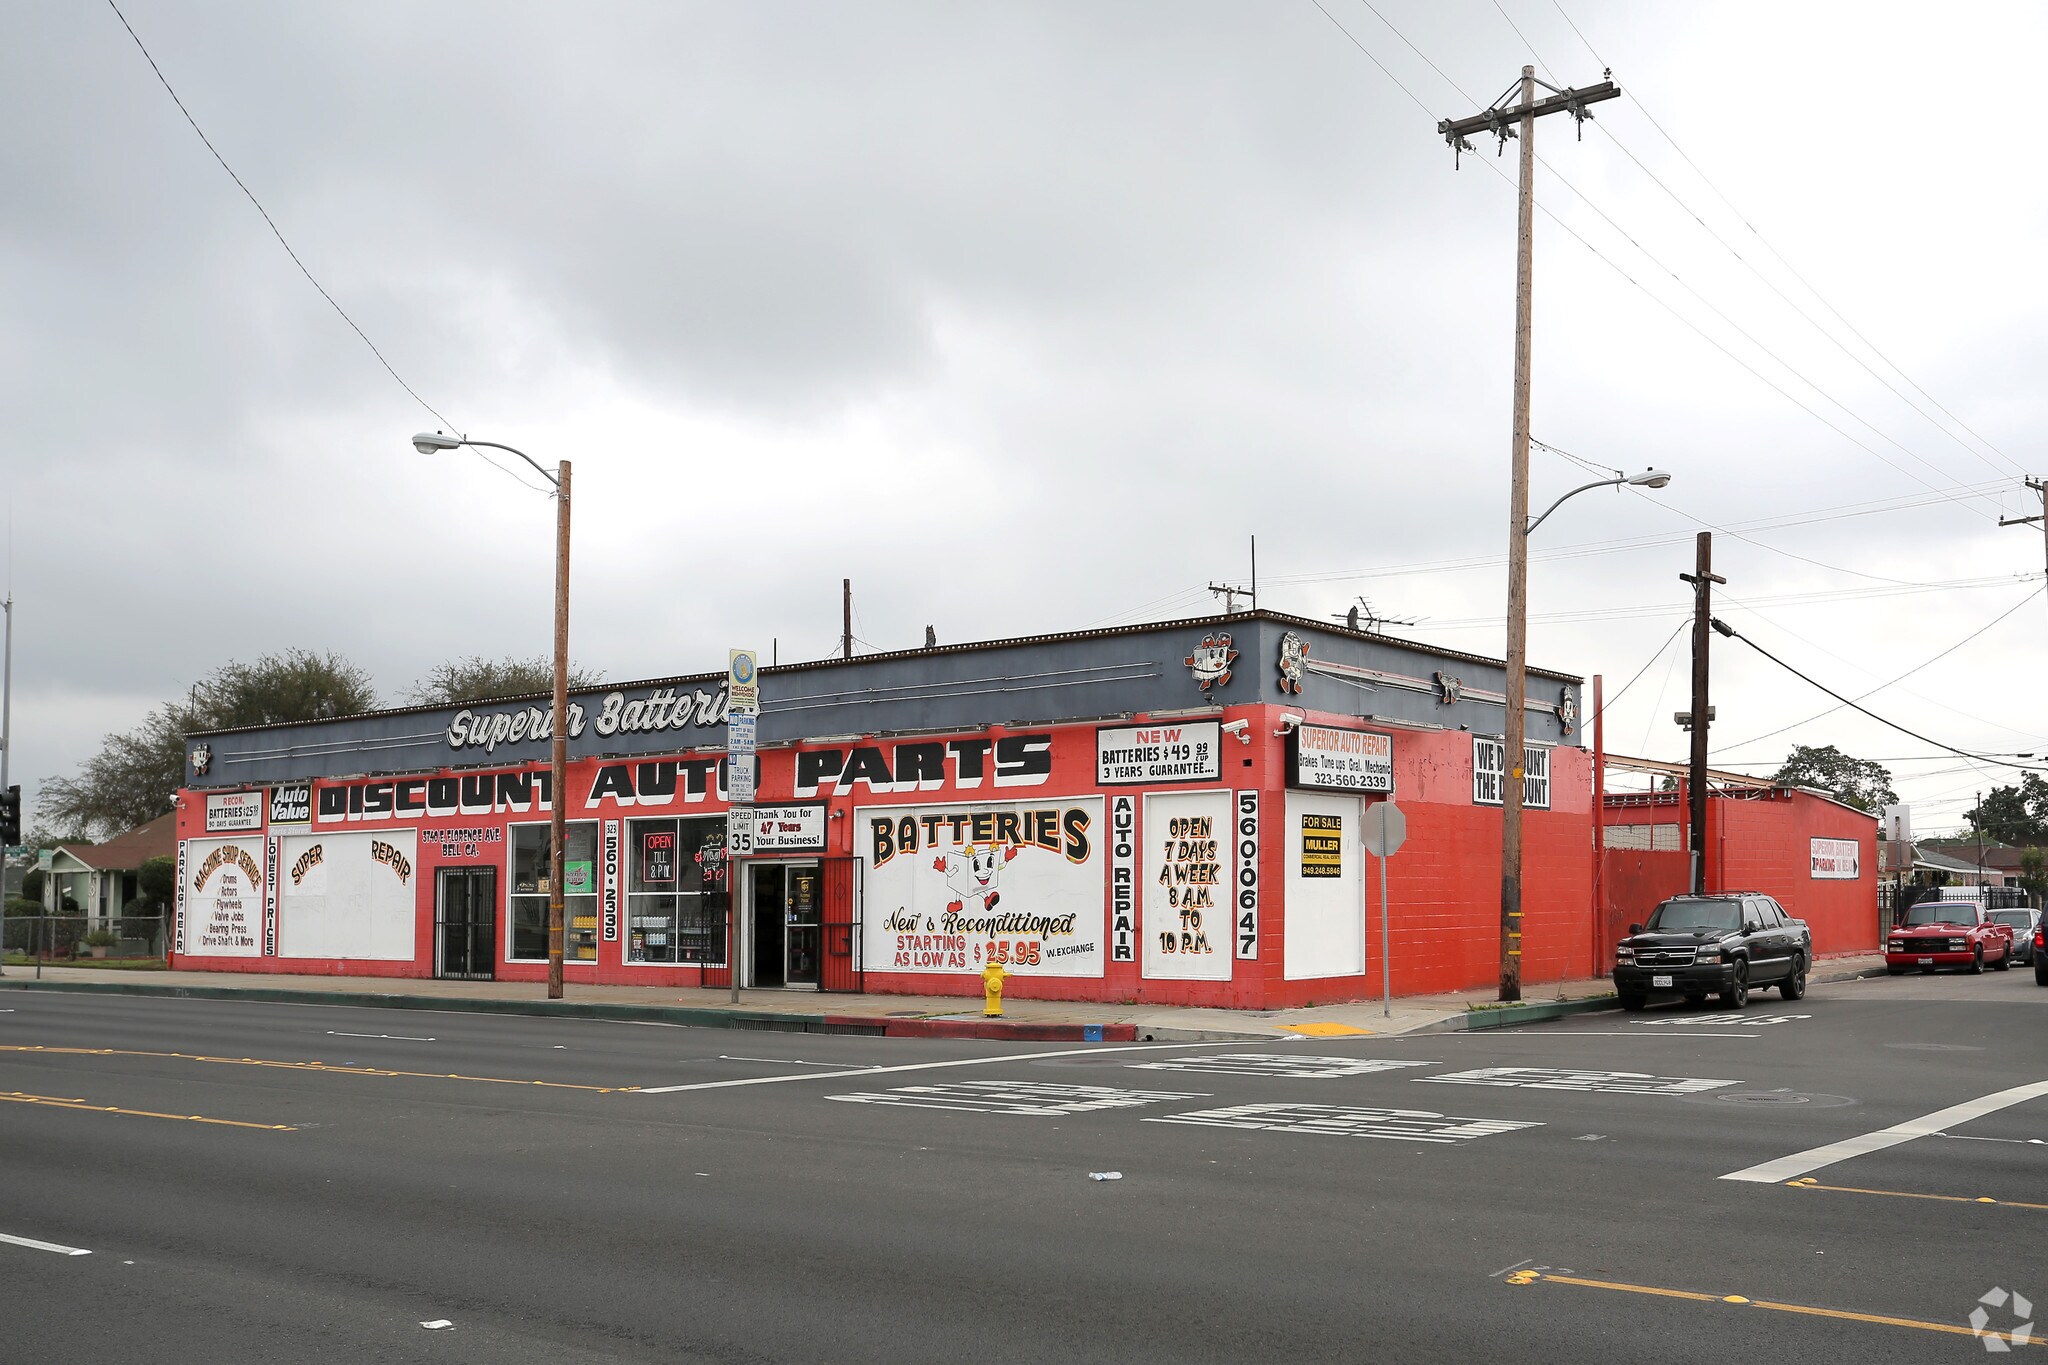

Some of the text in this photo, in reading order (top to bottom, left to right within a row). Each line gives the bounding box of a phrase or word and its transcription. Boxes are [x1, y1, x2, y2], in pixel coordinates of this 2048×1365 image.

[731, 685, 755, 693] WELCOME
[446, 700, 587, 752] Superir
[729, 714, 738, 726] NO
[1136, 728, 1182, 745] NEW
[1301, 727, 1388, 757] SUPERIOR AUTO REPAIR
[1102, 746, 1160, 765] BATTERIES
[1299, 752, 1318, 768] Brakes
[1320, 754, 1335, 768] Tune
[1335, 758, 1346, 773] ups
[1365, 760, 1391, 775] Mechanic
[1477, 742, 1494, 771] WE
[734, 766, 750, 775] TRUCK
[793, 734, 1052, 799] PARTS
[1103, 767, 1111, 779] 3
[1114, 765, 1143, 779] YEARS
[731, 774, 752, 783] PARKING
[1314, 772, 1387, 788] 323-560-2339
[1476, 772, 1496, 800] THE
[273, 786, 309, 804] Auto
[209, 806, 243, 819] BATTERIES
[271, 803, 309, 820] Value
[731, 812, 752, 820] SPEED
[755, 809, 812, 819] Thank You for
[216, 820, 227, 828] DAYS
[228, 818, 252, 827] GUARANTEE
[607, 824, 616, 834] 323
[761, 821, 801, 834] 47 Years
[1169, 816, 1212, 839] OPEN
[1303, 816, 1341, 828] FOR SALE
[446, 827, 483, 843] FLORENCE
[484, 827, 502, 843] AVE.
[648, 835, 672, 849] OPEN
[731, 833, 751, 851] 35
[756, 835, 820, 846] Your Business!
[870, 807, 1092, 869] BATTERIES
[442, 843, 480, 857] BELL CA.
[1164, 840, 1217, 863] 7 DAYS
[1305, 839, 1339, 851] MULLER
[291, 843, 324, 886] SUPER
[371, 839, 411, 886] REPAIR
[653, 850, 667, 863] TILL
[1815, 857, 1835, 872] PARKING
[194, 845, 263, 893] MACHINE SHOP SERVICE
[1158, 863, 1221, 887] A WEEK
[1114, 797, 1132, 959] AUTO REPAIR
[266, 837, 277, 955] LOWEST PRICES
[1168, 886, 1214, 909] 8 A.M.
[216, 898, 242, 911] Flywheels
[214, 910, 244, 922] Valve Jobs
[883, 906, 921, 933] New
[941, 911, 1077, 941] Reconditioned
[1179, 908, 1203, 931] TO
[176, 911, 185, 951] REAR
[209, 923, 247, 936] Bearing Press
[202, 935, 217, 947] Drive
[217, 935, 233, 946] Shaft
[240, 937, 254, 947] More
[896, 935, 966, 951] STARTING
[1159, 931, 1213, 953] 10 P.M.
[973, 941, 1042, 966] $ 25.95
[1046, 942, 1095, 958] W.EXCHANGE
[894, 951, 966, 967] AS LOW AS
